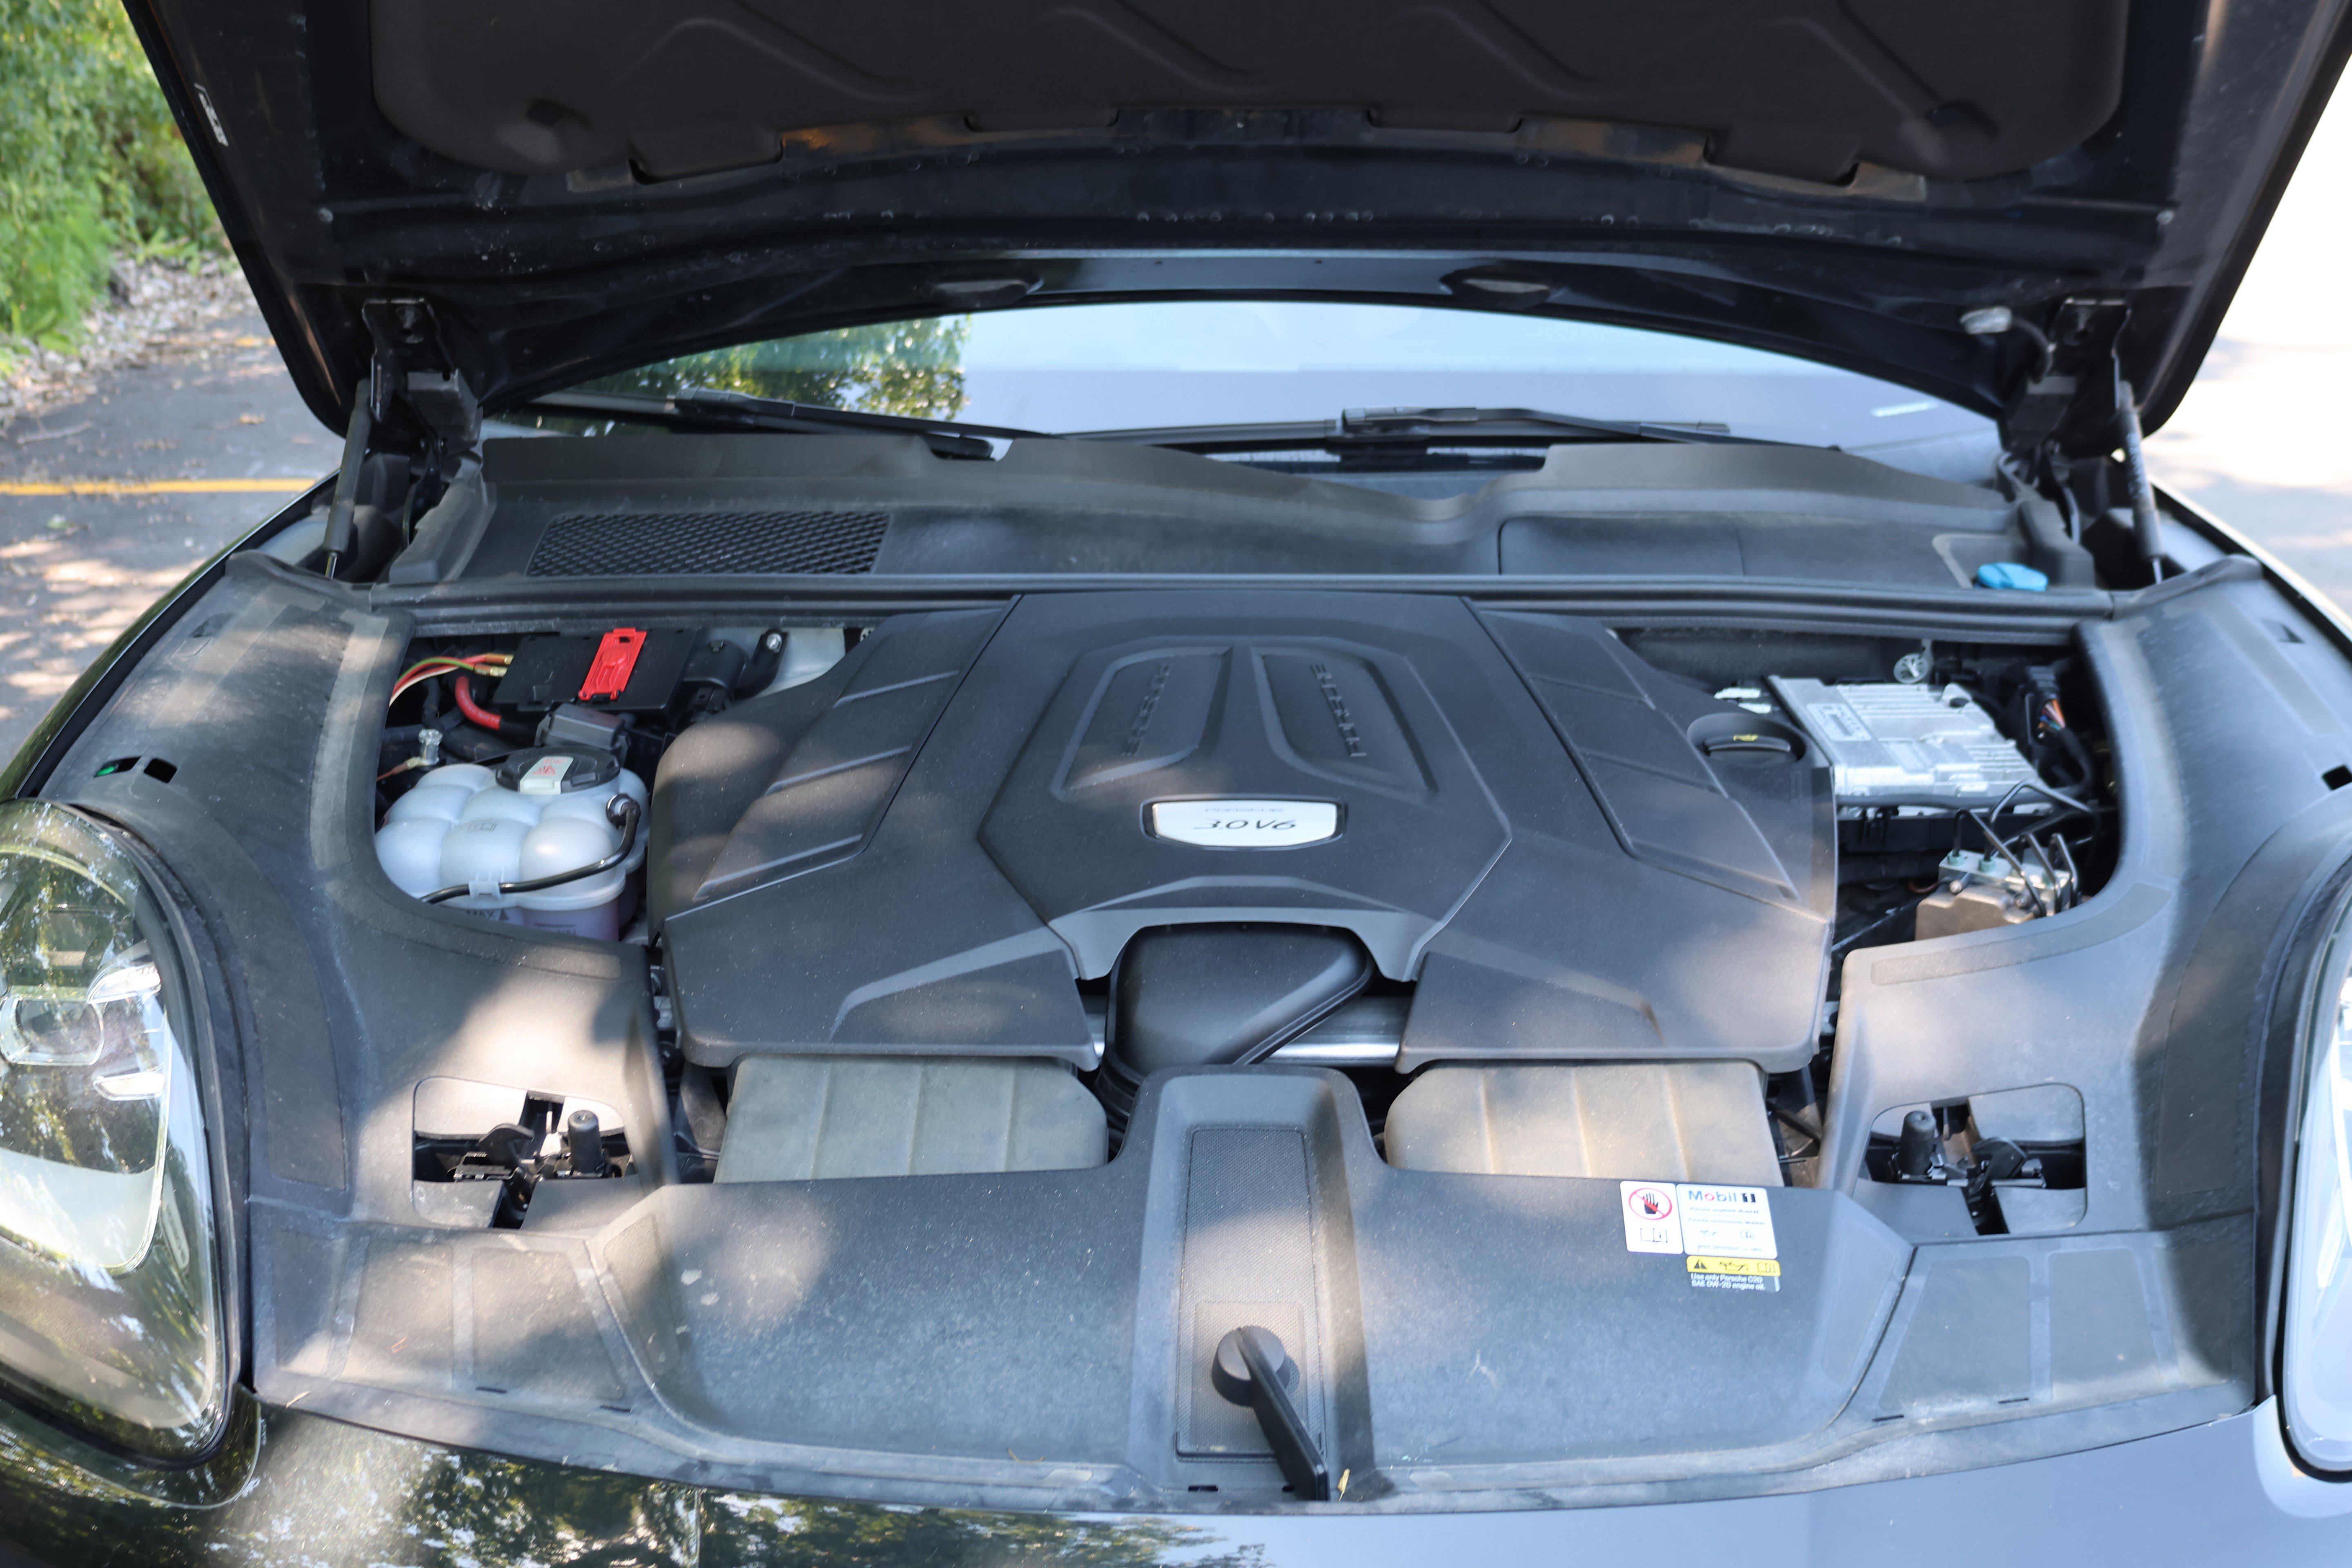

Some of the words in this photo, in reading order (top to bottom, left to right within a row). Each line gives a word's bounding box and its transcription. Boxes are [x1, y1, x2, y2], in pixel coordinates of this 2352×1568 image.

[1193, 819, 1248, 830] 3.0
[1256, 819, 1296, 830] V6
[1688, 1190, 1737, 1202] Mobil
[1720, 1274, 1747, 1283] Porsche
[1691, 1279, 1706, 1287] SAE
[1732, 1283, 1755, 1291] engine
